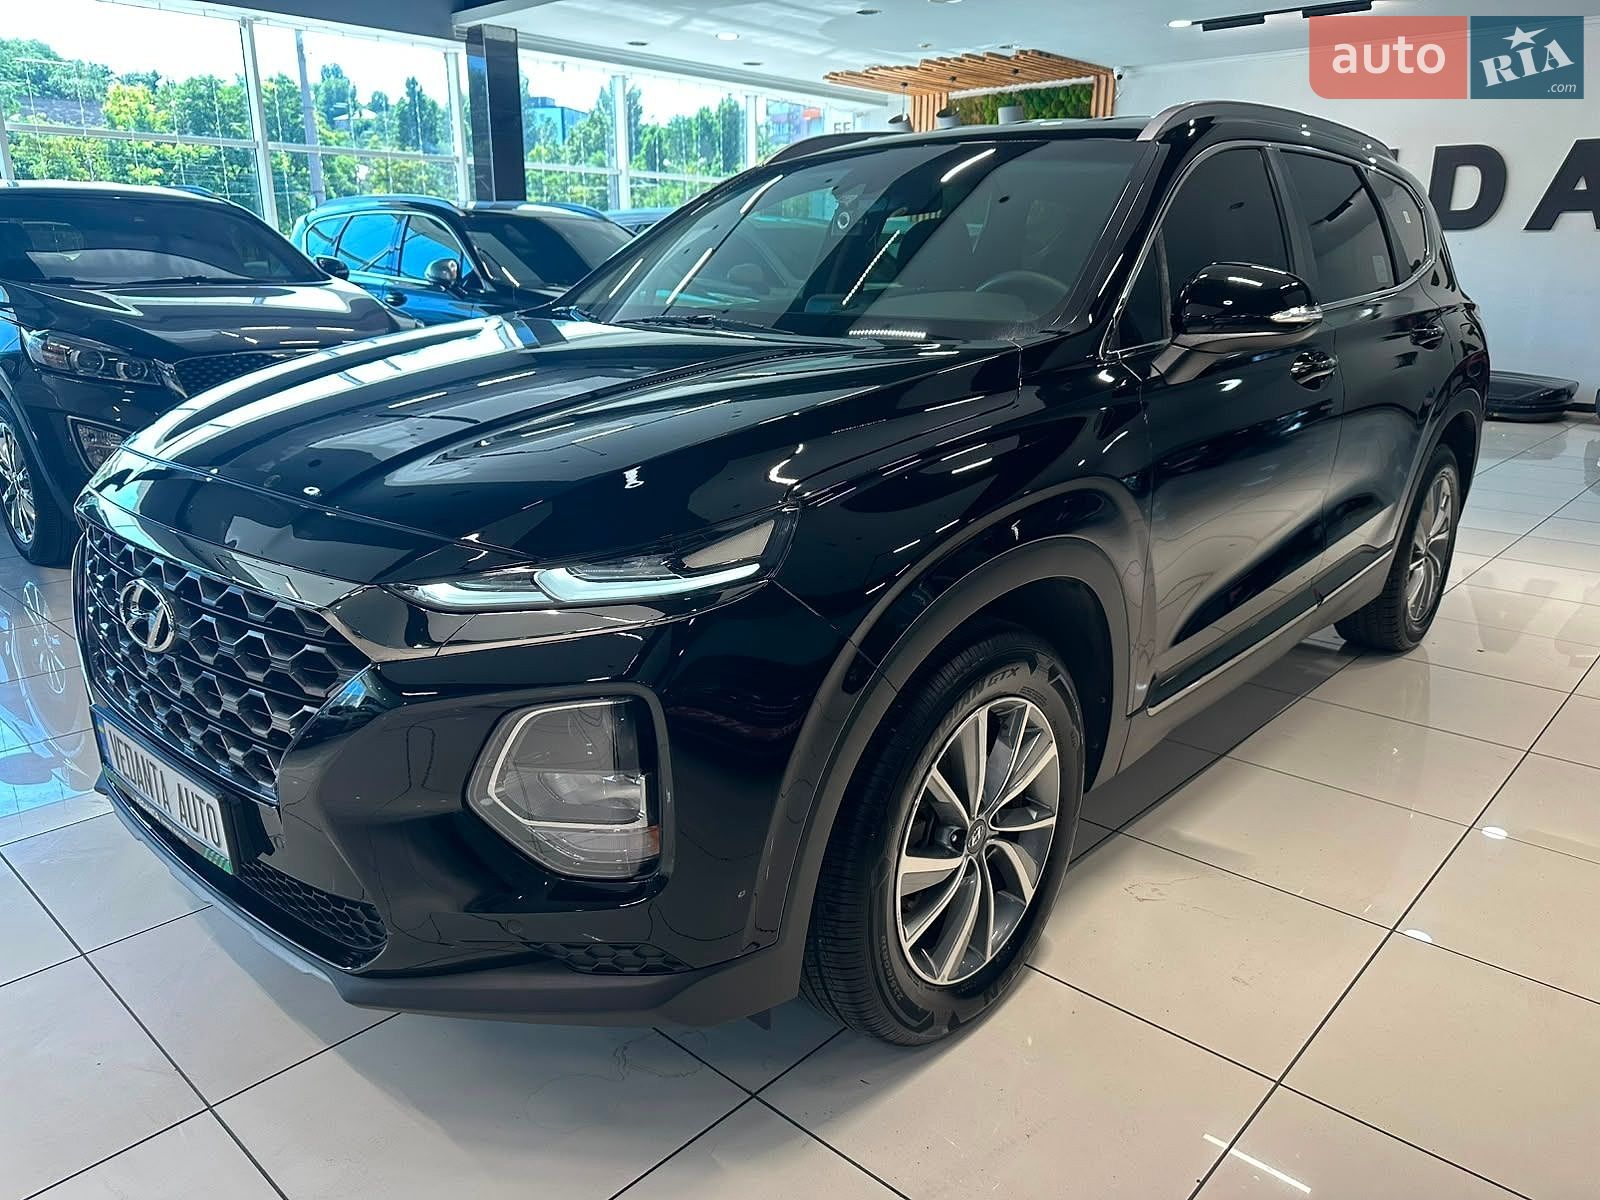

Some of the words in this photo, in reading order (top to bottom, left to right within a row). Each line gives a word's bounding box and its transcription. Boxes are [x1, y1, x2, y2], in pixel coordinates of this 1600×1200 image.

[1389, 138, 1600, 231] DA
[107, 729, 172, 814] VEDANTA
[176, 782, 222, 849] AUTO
